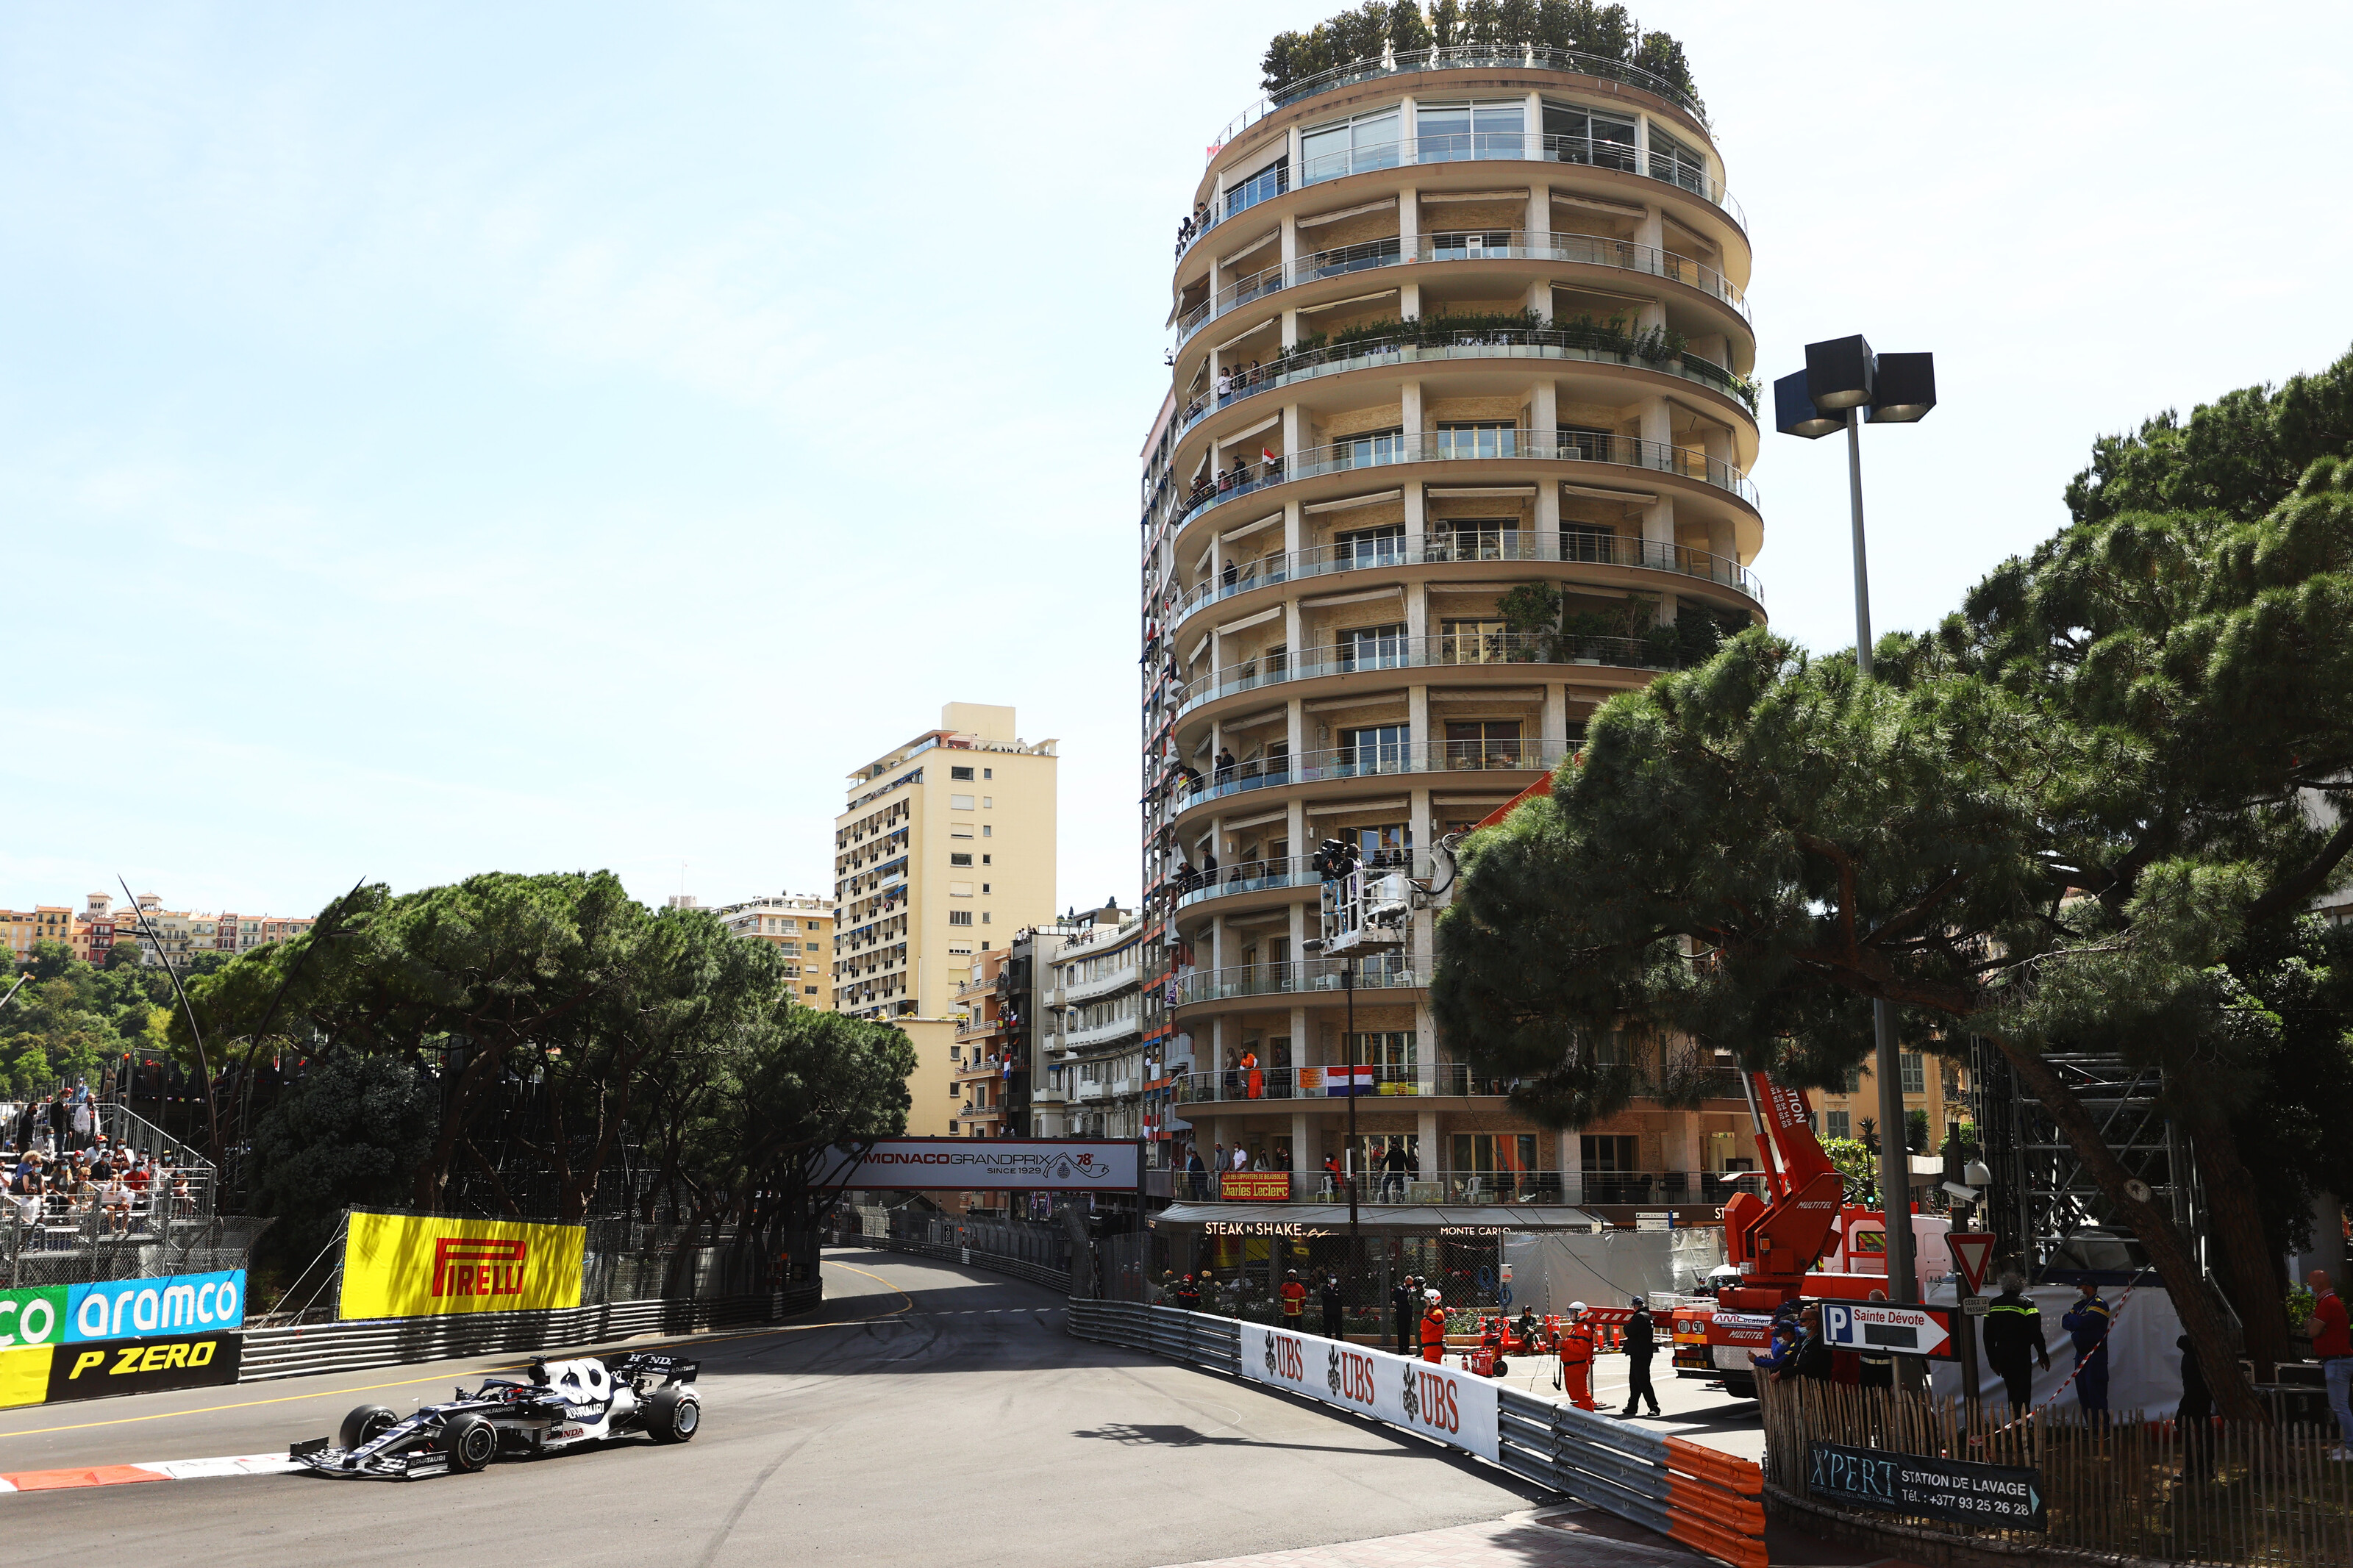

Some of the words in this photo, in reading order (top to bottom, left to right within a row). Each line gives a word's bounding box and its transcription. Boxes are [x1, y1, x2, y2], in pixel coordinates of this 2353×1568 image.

[1222, 1184, 1251, 1197] Charles
[1253, 1184, 1288, 1197] Leclerc
[1796, 1201, 1832, 1209] MULTITEL
[1205, 1222, 1244, 1235] STEAK
[1246, 1225, 1253, 1234] N
[1256, 1222, 1302, 1236] SHAKE
[1440, 1227, 1475, 1235] MONTE
[432, 1238, 526, 1297] PIRELLI
[77, 1281, 238, 1338] aramco
[1679, 1321, 1689, 1332] 80
[1693, 1322, 1703, 1333] 90
[1829, 1307, 1847, 1341] P
[1854, 1309, 1885, 1322] Sainte
[1888, 1311, 1924, 1325] Dévote
[1728, 1331, 1765, 1339] MULTITEL
[68, 1350, 105, 1380] P
[109, 1341, 217, 1375] ZERO
[1276, 1336, 1303, 1382] UBS
[671, 1365, 696, 1373] ALPHATAURI
[1341, 1351, 1375, 1406] UBS
[1419, 1371, 1460, 1434] UBS
[565, 1403, 604, 1420] ALPHATAURI
[410, 1455, 446, 1467] ALPHATAURI
[1902, 1470, 1949, 1487] STATION
[1952, 1476, 1970, 1489] DE
[1973, 1479, 2027, 1496] LAVAGE
[1854, 1493, 1871, 1502] LAVAGE
[1902, 1489, 1921, 1503] Tél.
[1929, 1494, 1956, 1507] +377
[1958, 1497, 1973, 1509] 93
[1977, 1499, 1991, 1511] 25
[1994, 1501, 2010, 1514] 26
[2013, 1503, 2029, 1516] 28
